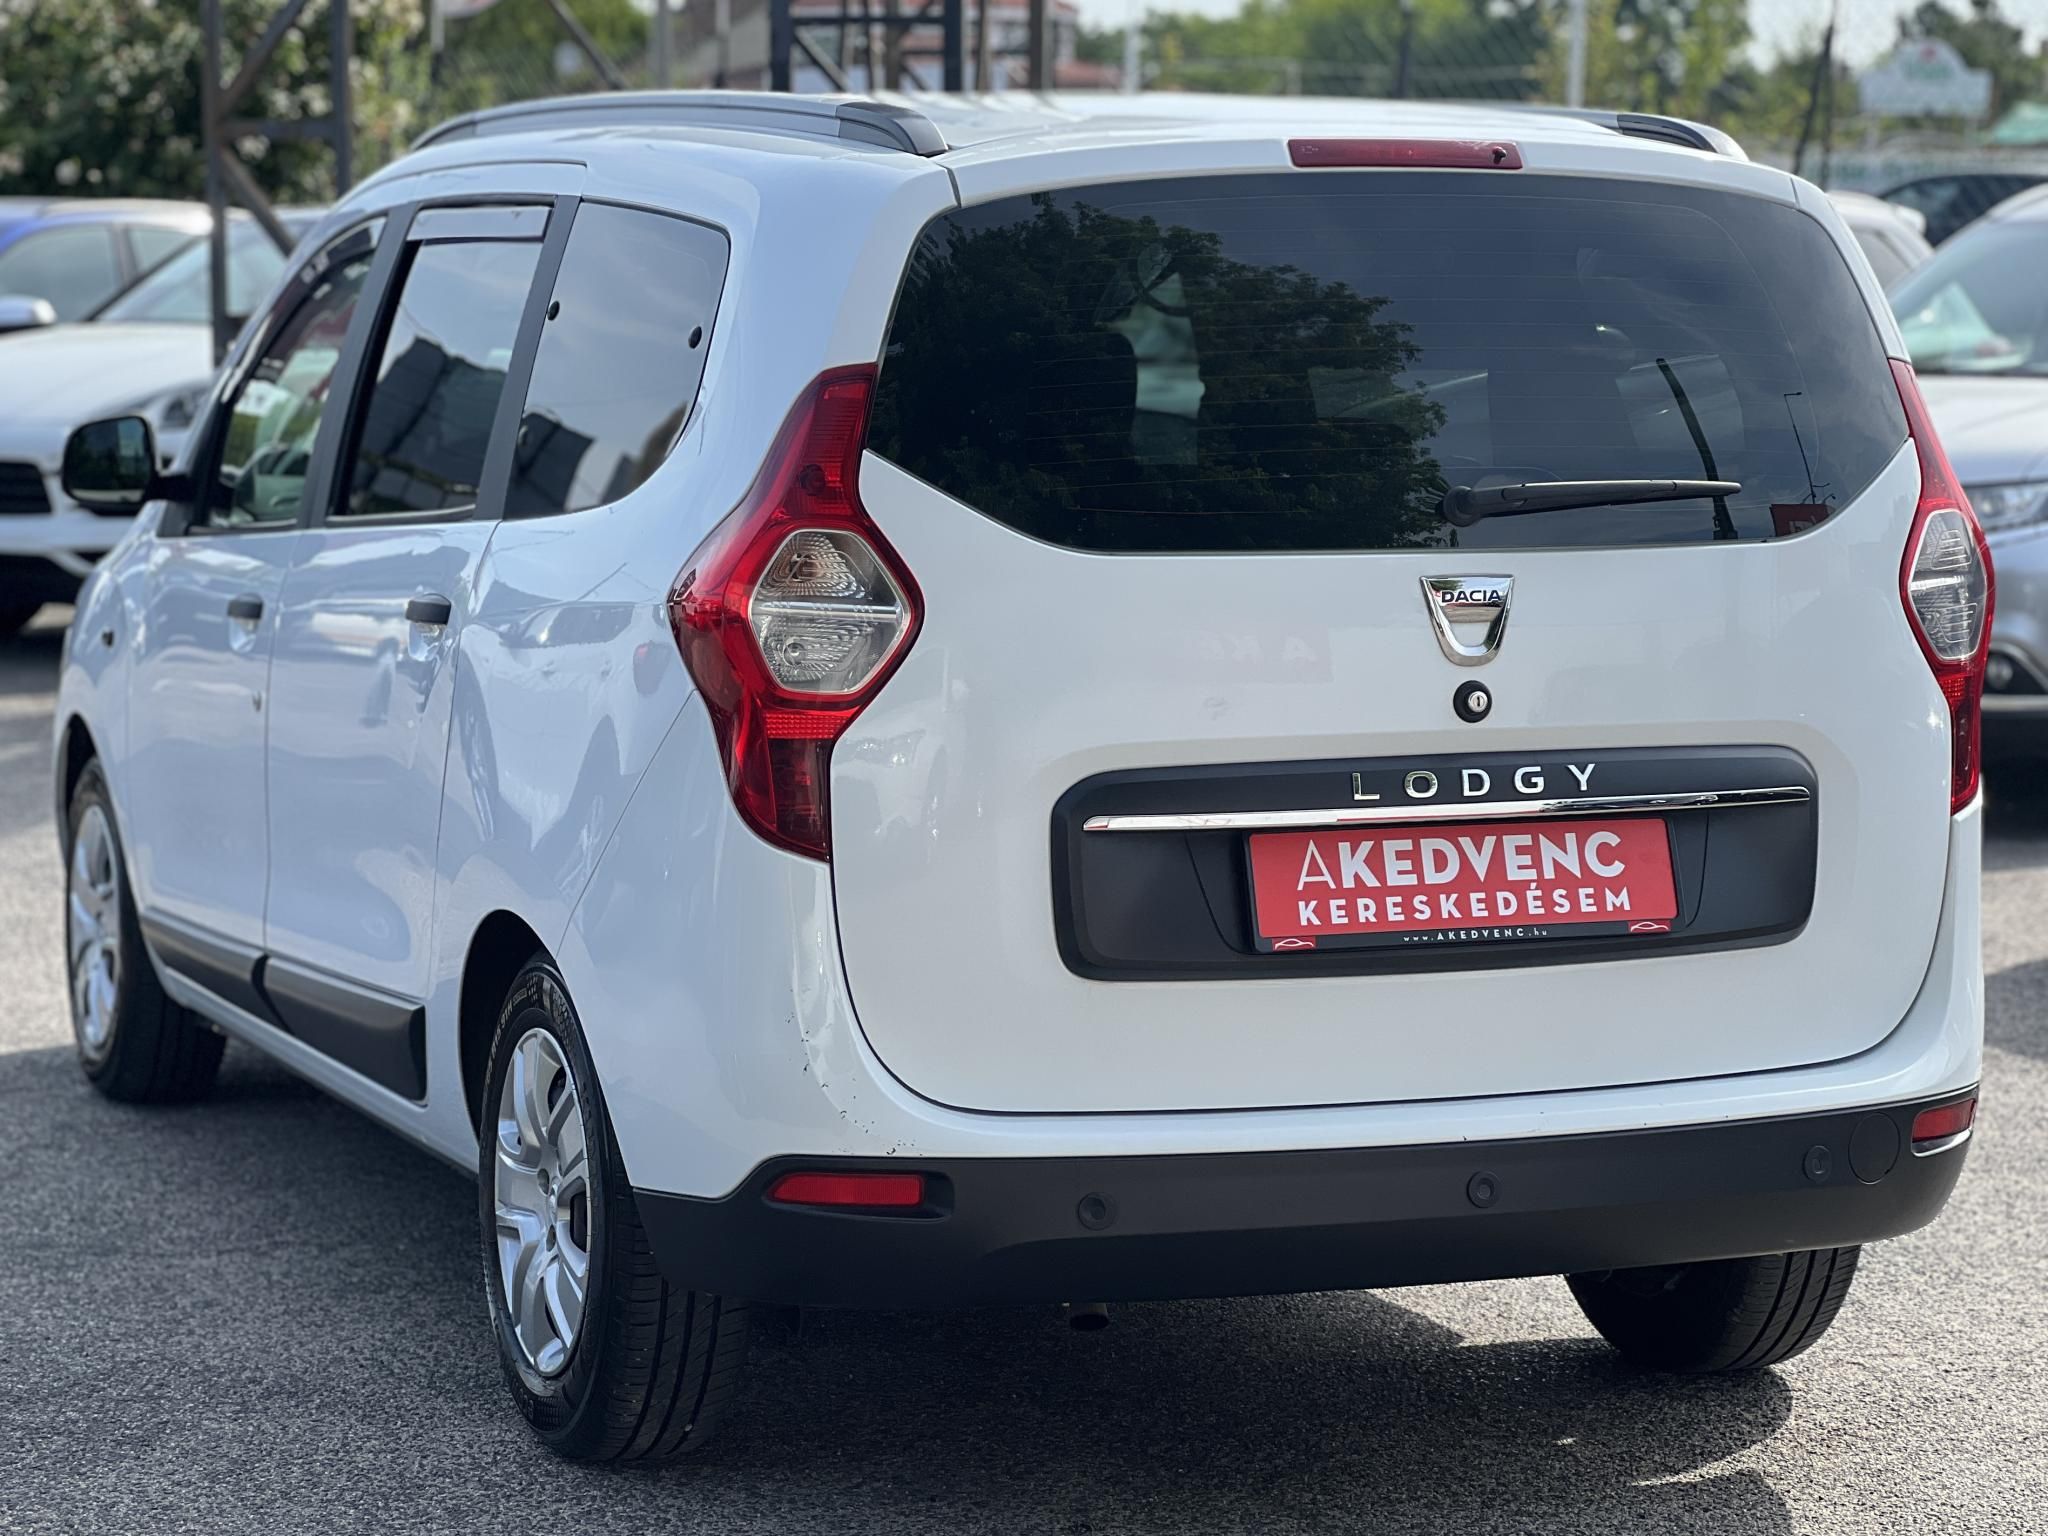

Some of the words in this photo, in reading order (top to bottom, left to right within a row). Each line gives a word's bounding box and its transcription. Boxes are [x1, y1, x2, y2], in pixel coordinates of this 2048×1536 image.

[1441, 590, 1501, 602] DACIA
[1351, 763, 1596, 800] LODGY
[1298, 881, 1632, 926] KERESKEDÉSEM
[1403, 927, 1548, 942] www.AKEDVENC.hu
